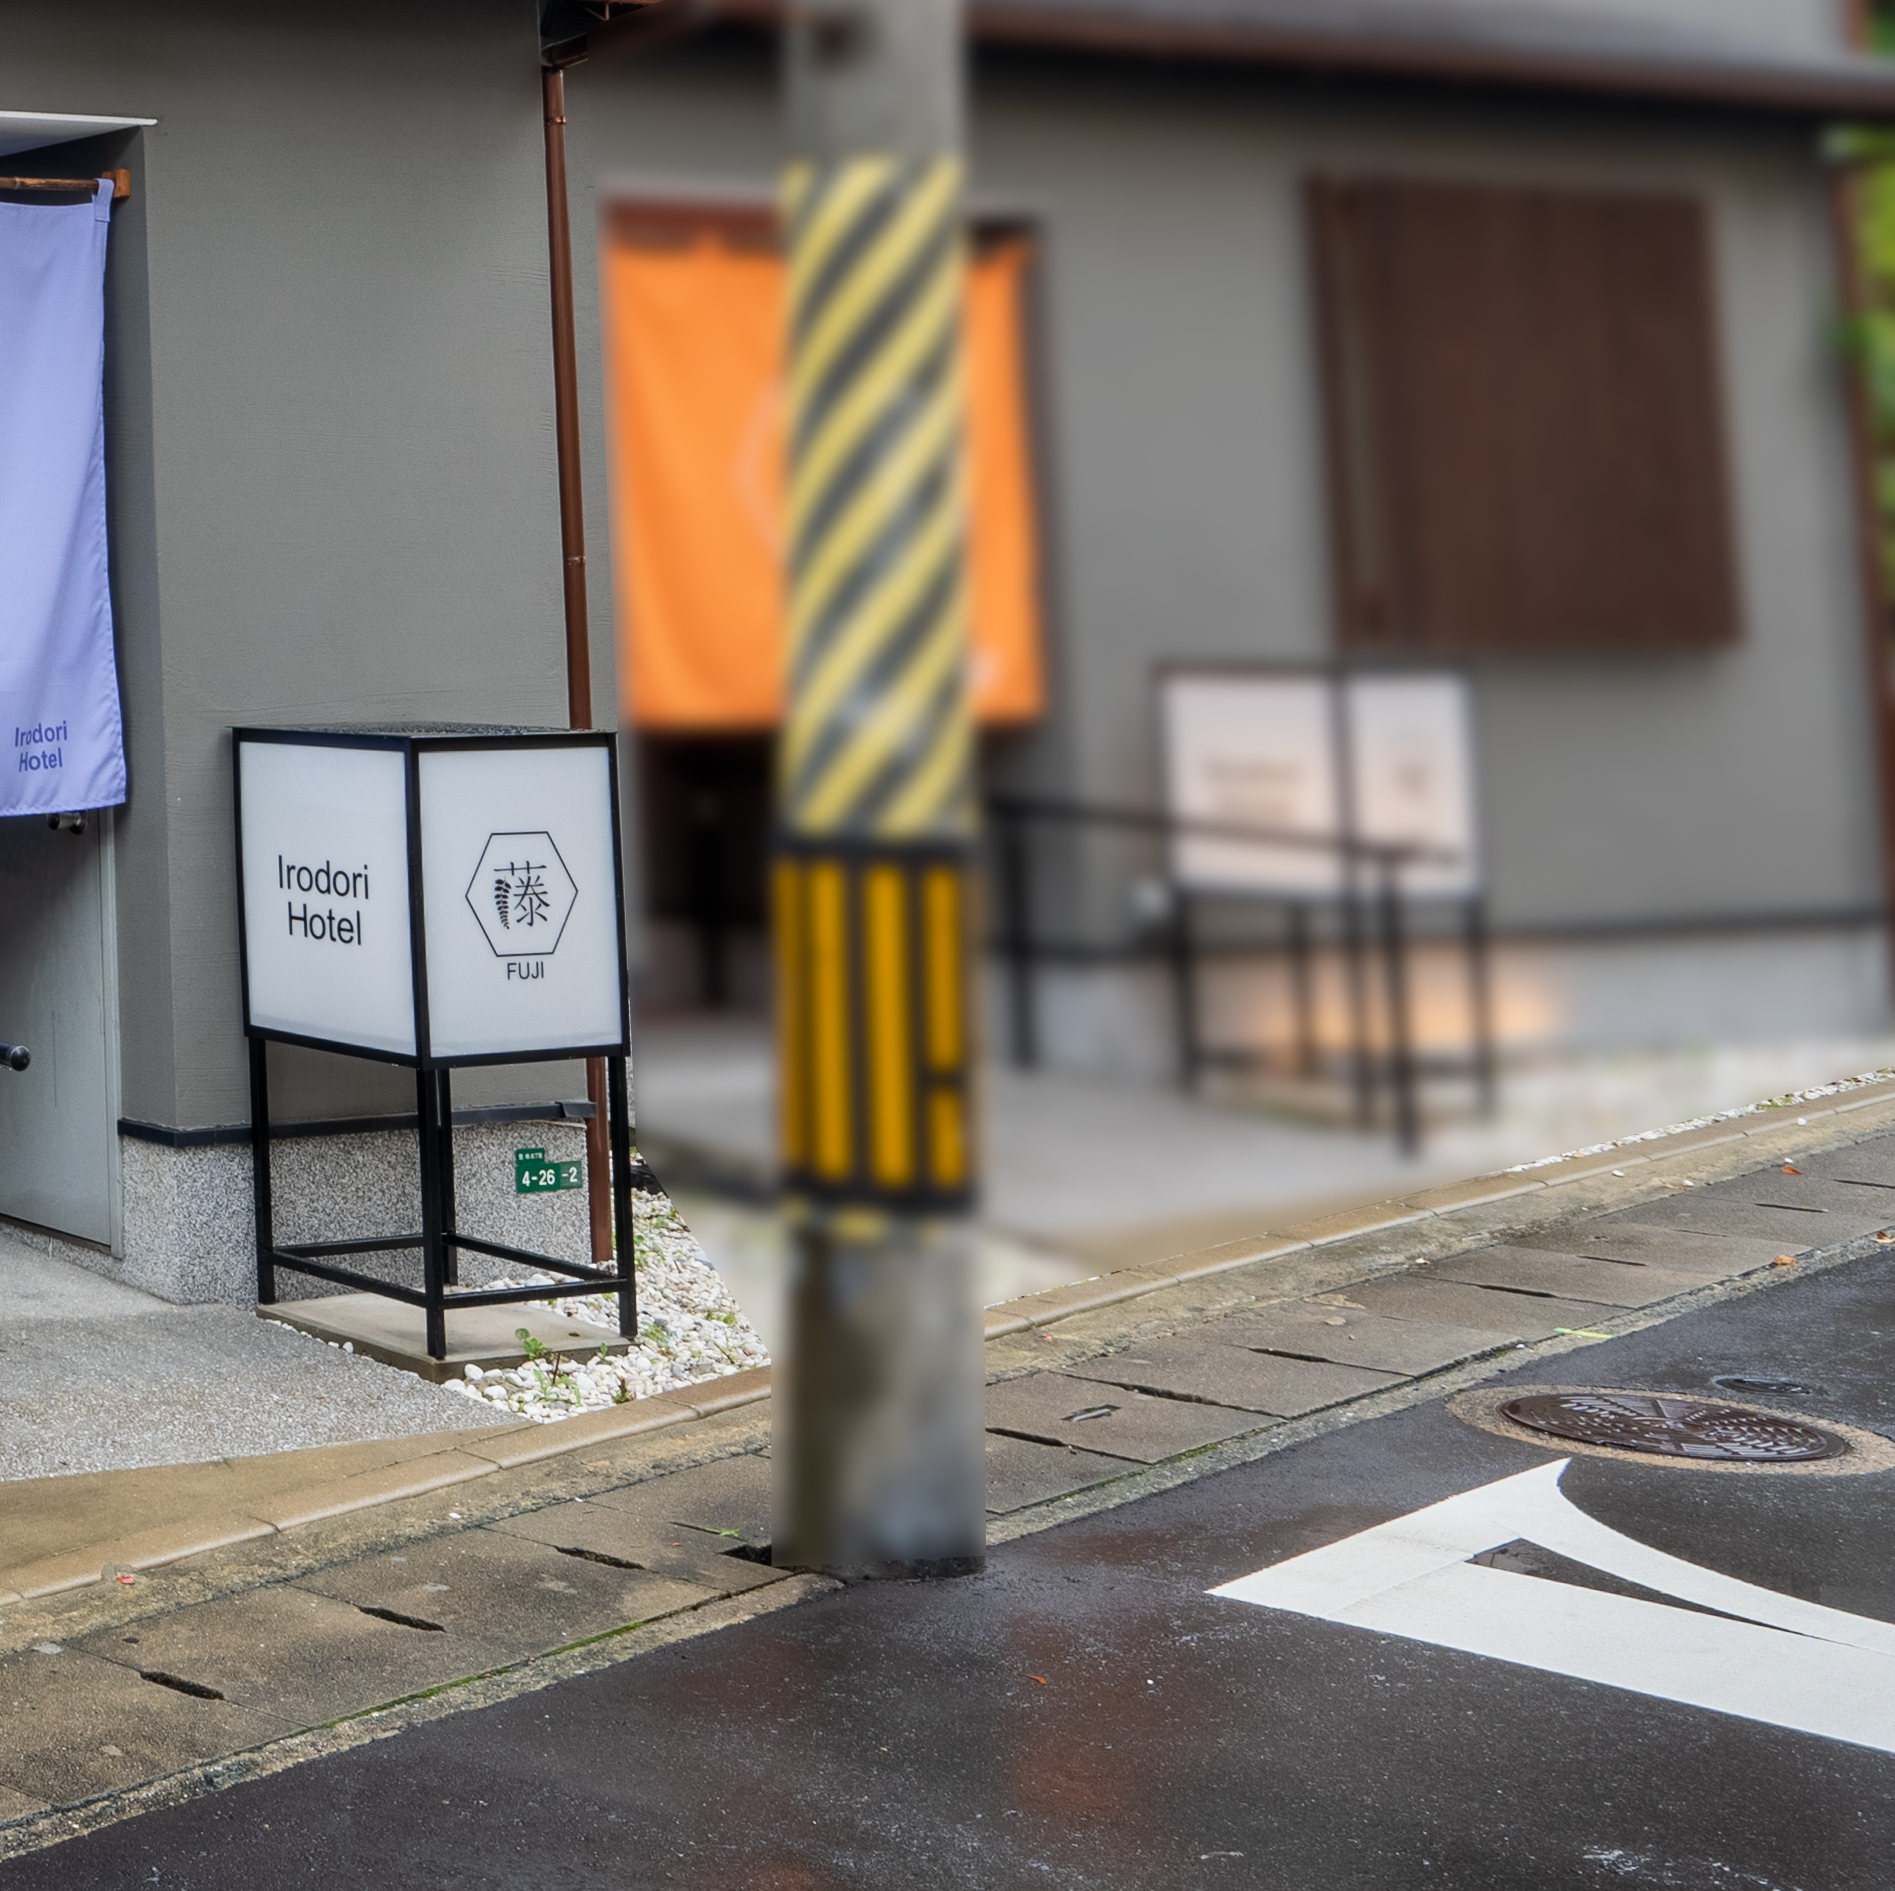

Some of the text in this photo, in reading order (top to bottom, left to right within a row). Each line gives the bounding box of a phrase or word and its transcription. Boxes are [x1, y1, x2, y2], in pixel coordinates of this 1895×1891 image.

[15, 720, 67, 747] Irodori
[18, 747, 62, 773] Hotel
[278, 854, 369, 900] Irodori
[288, 901, 362, 946] Hotel
[507, 961, 544, 980] FUJI
